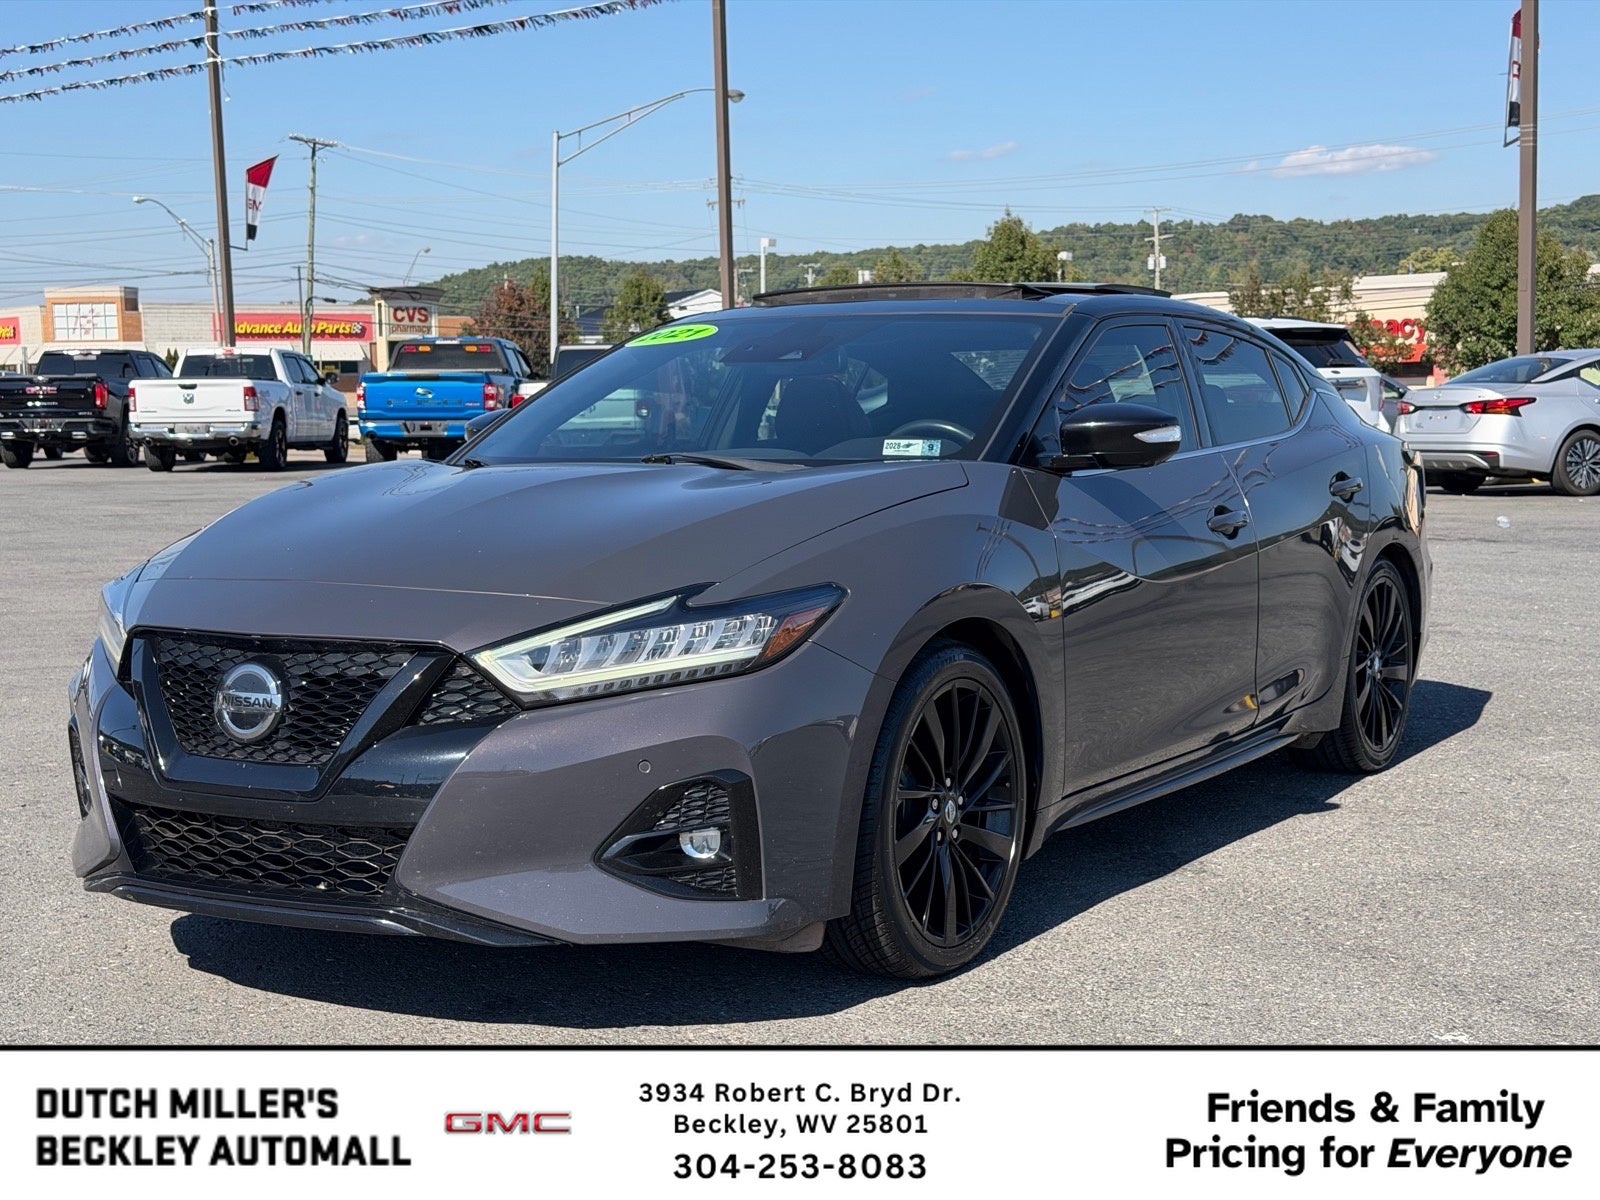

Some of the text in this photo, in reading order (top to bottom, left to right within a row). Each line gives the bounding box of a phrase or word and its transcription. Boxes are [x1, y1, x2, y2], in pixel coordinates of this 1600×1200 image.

[392, 305, 430, 323] CVS
[316, 321, 350, 334] Parts
[391, 324, 431, 335] pharmacy
[885, 442, 934, 451] 2028 9
[222, 694, 273, 709] NISSAN
